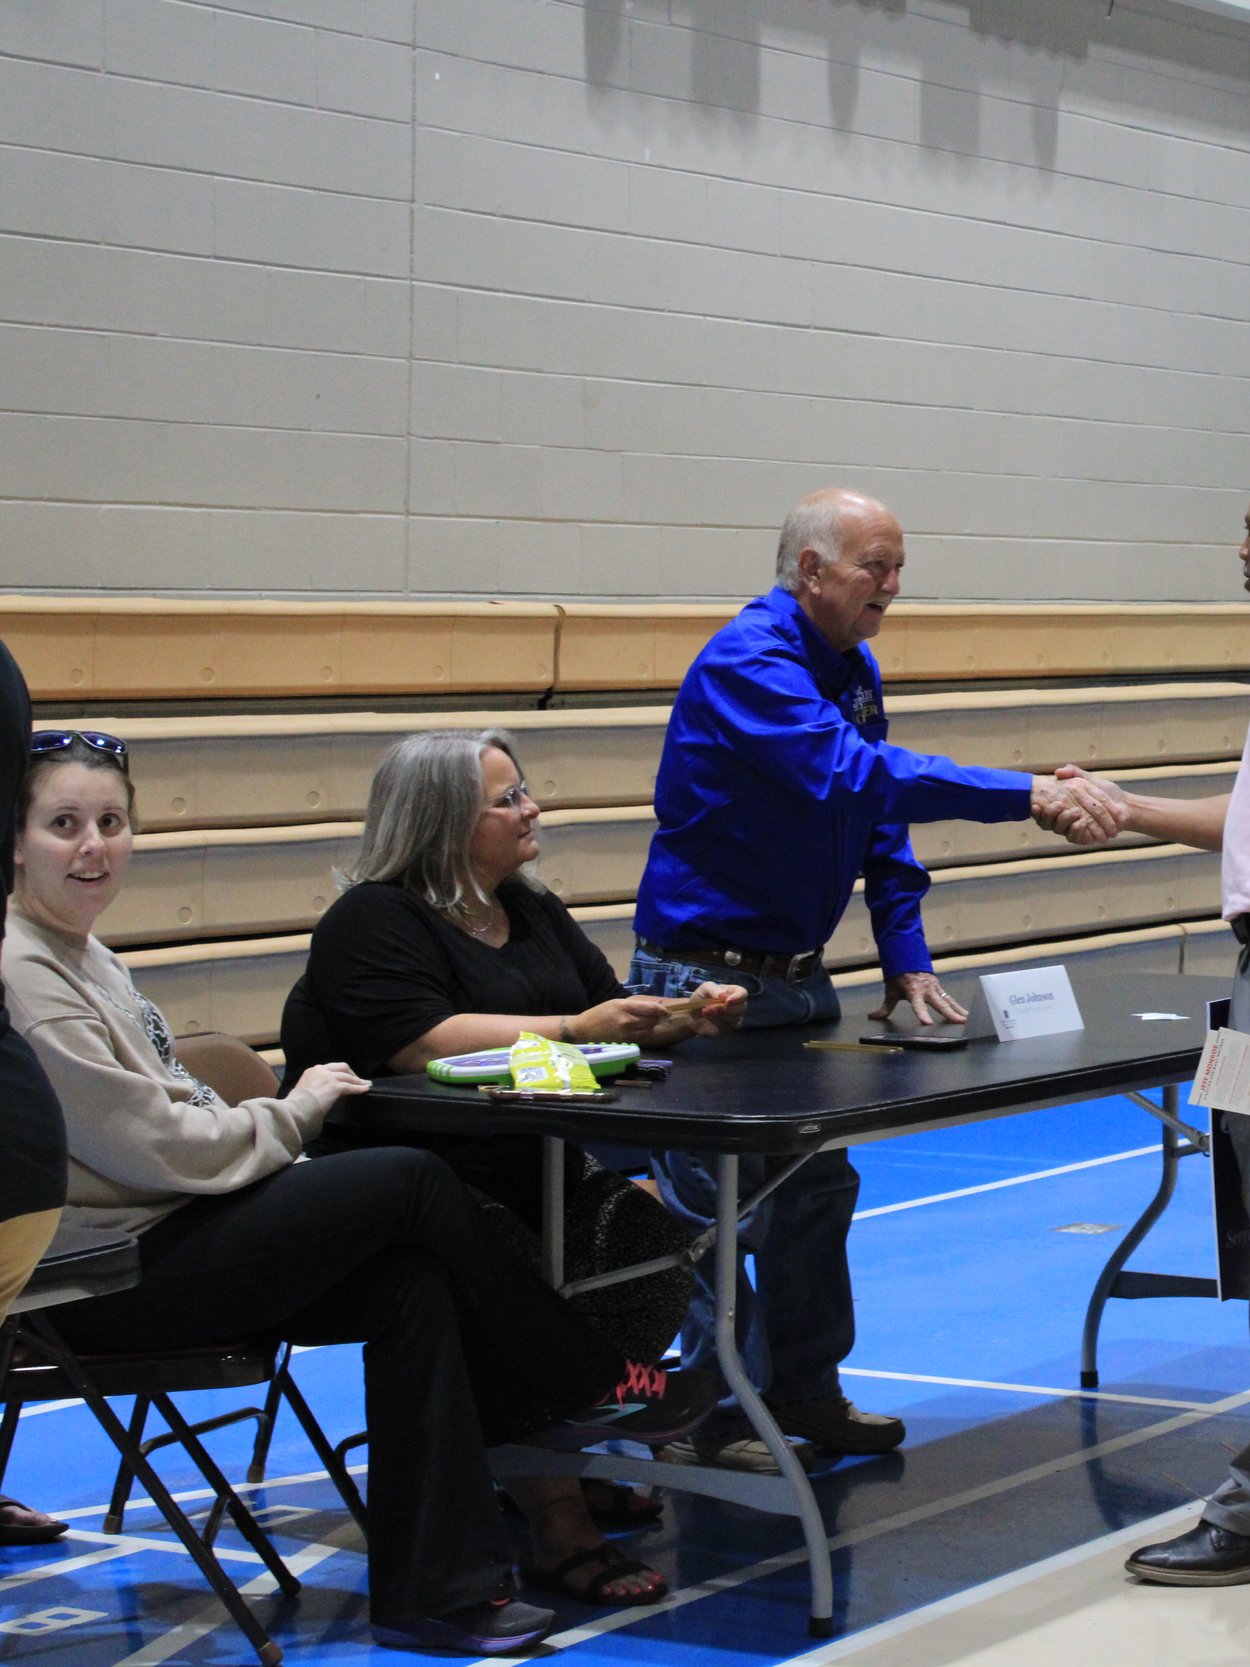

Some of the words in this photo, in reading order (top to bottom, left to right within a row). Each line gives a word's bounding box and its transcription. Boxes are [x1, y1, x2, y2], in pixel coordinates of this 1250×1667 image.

[1009, 994, 1026, 1005] Glen
[1027, 992, 1055, 1003] Johnson
[1201, 1077, 1209, 1092] JEFF
[1205, 1044, 1218, 1076] MONROE
